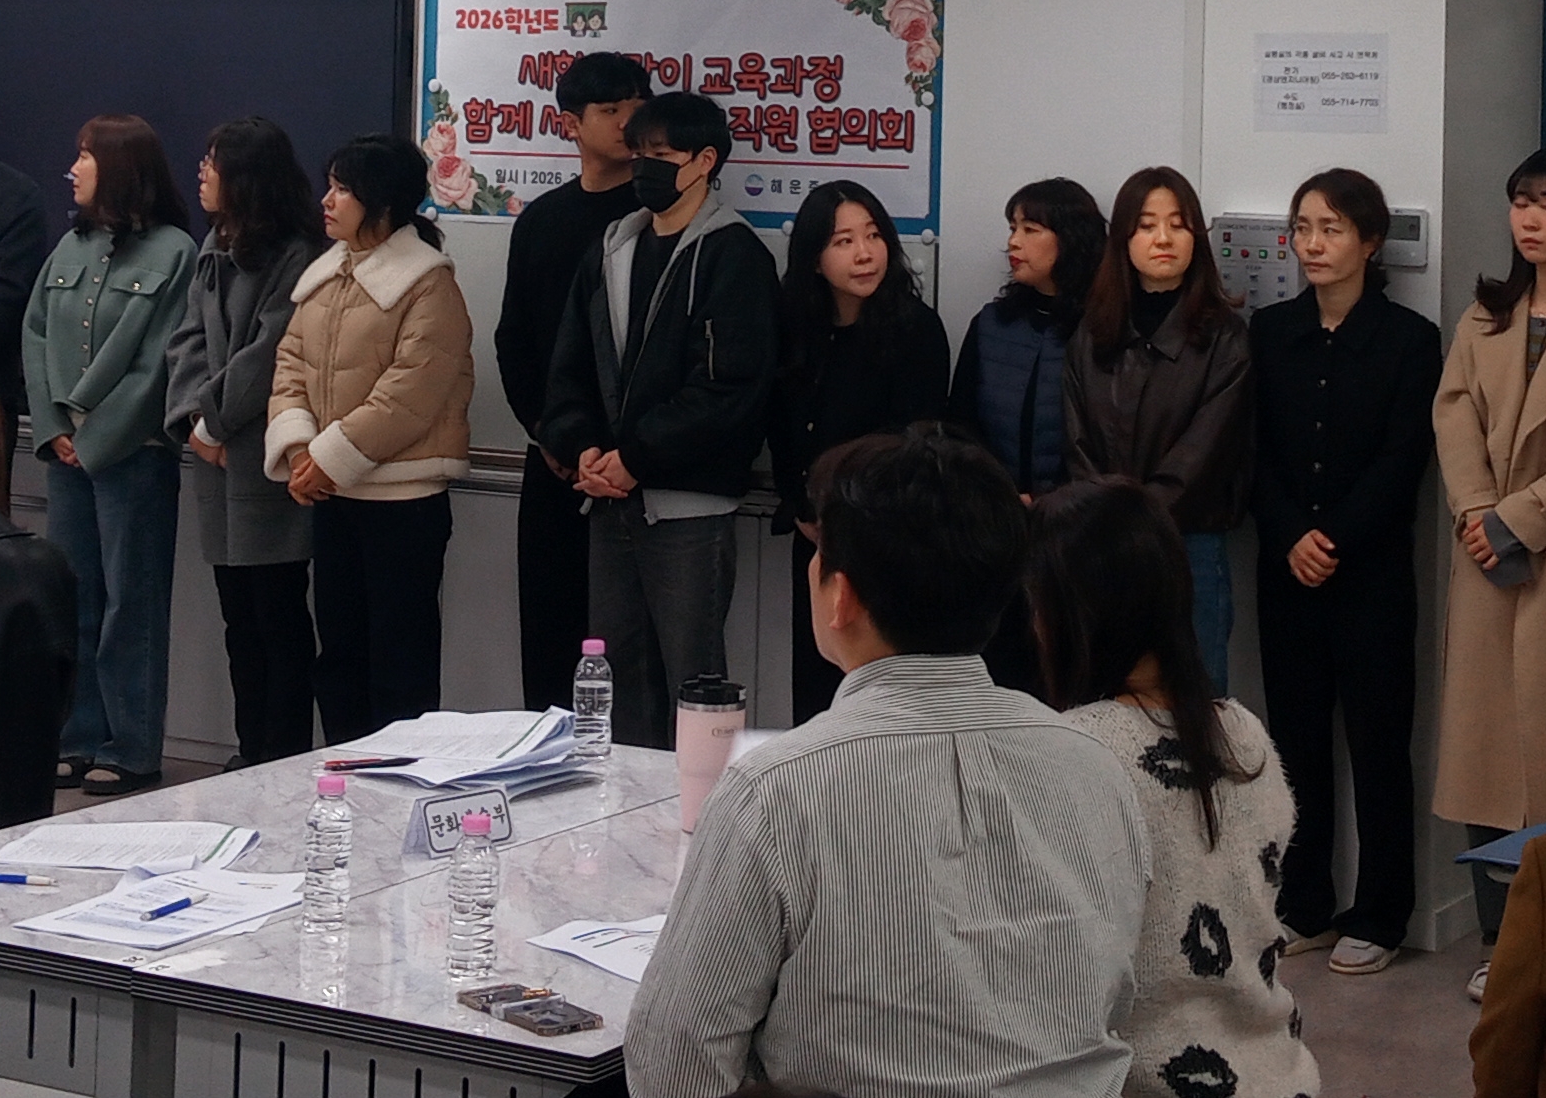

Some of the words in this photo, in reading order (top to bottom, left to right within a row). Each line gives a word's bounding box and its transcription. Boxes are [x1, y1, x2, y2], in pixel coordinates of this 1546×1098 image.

[455, 7, 559, 35] 2026학년도
[698, 52, 845, 102] 교육과정
[463, 97, 534, 144] 함께
[727, 104, 799, 153] 직원
[806, 105, 915, 154] 협의회
[495, 168, 519, 185] 일시
[430, 804, 505, 837] 문화부
